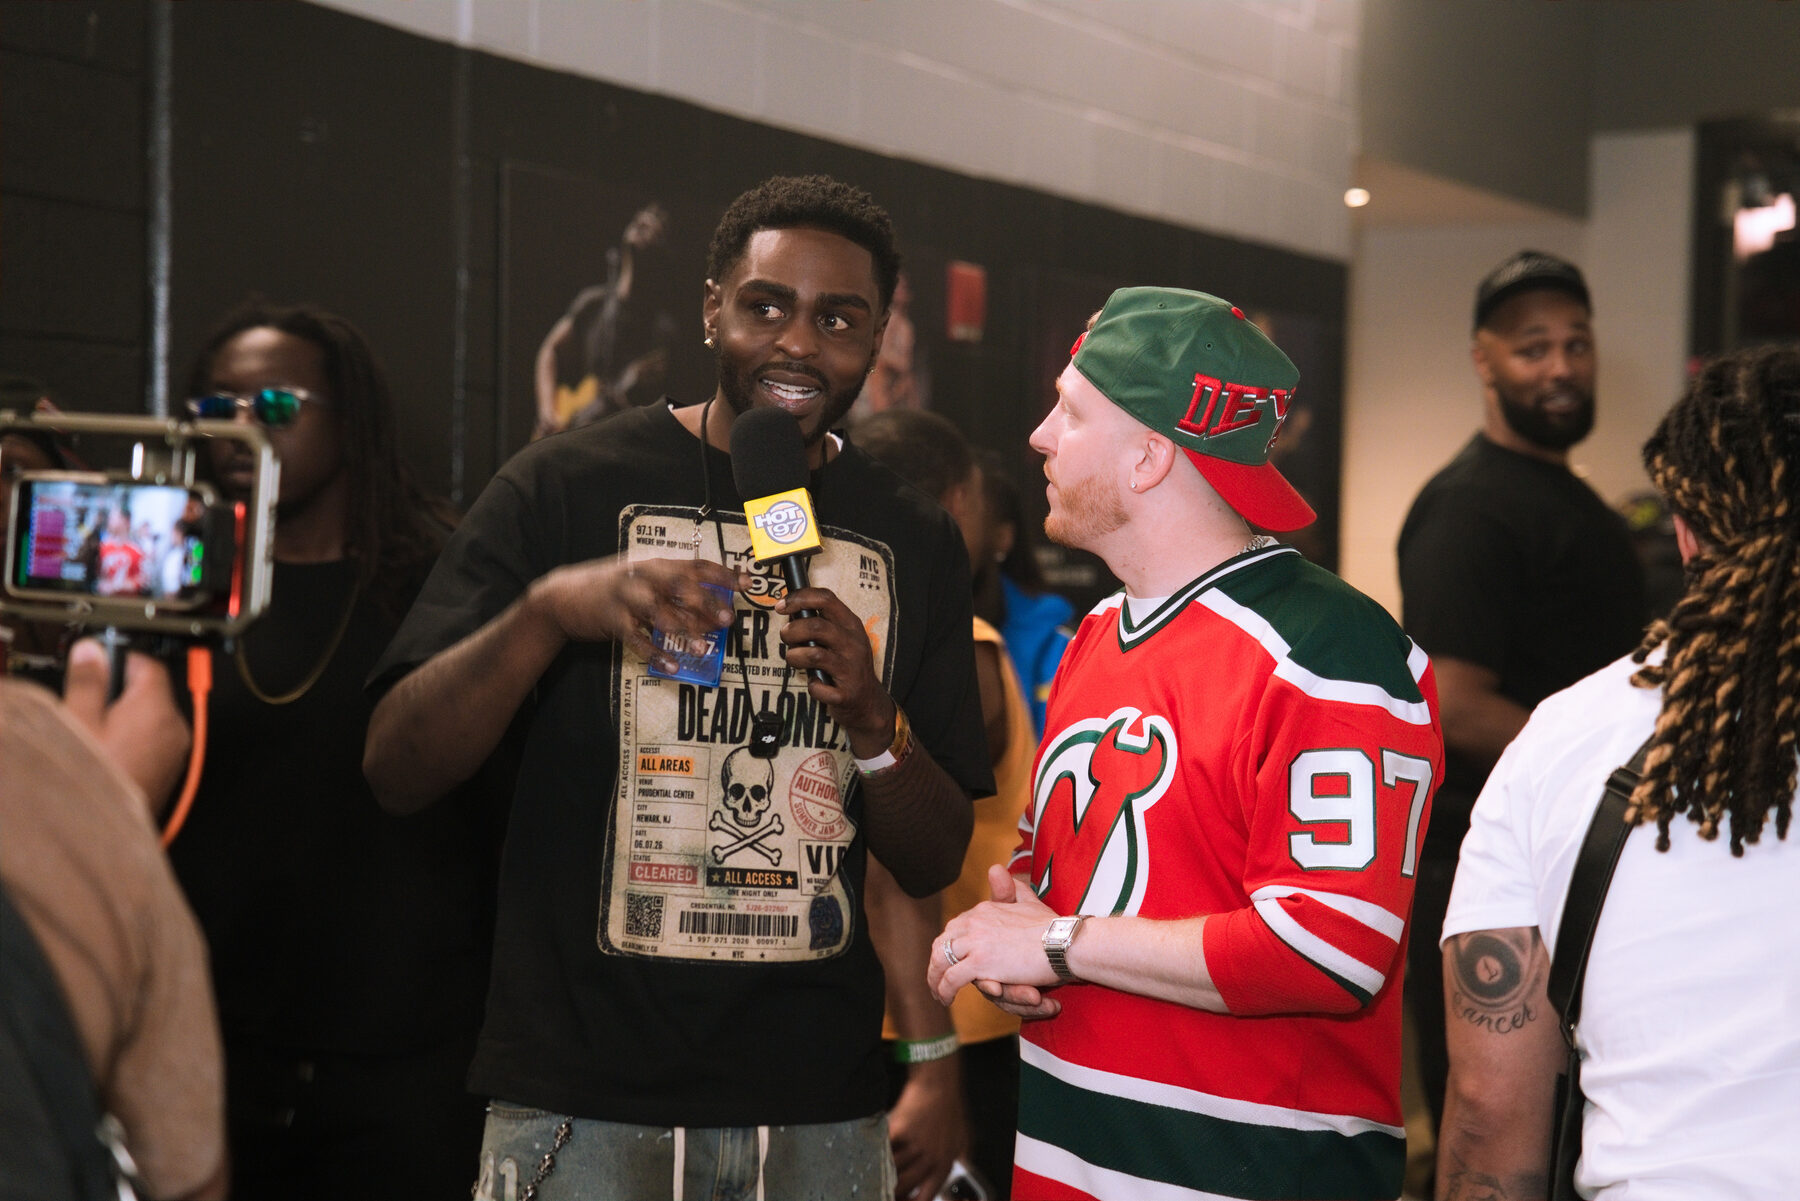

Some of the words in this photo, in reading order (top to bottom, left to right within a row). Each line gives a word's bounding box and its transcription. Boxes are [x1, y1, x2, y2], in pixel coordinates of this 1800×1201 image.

[753, 506, 800, 528] HOT
[636, 525, 652, 535] 97.1
[655, 526, 666, 537] FM
[773, 518, 804, 537] 97
[636, 538, 654, 546] WHERE
[679, 542, 693, 550] LIVES
[860, 554, 878, 574] NYC
[750, 576, 786, 596] 97
[722, 663, 760, 676] PRESETED
[762, 666, 770, 676] BY
[625, 679, 632, 690] FM
[677, 684, 748, 745] DEAD
[761, 735, 776, 744] dji
[621, 749, 630, 781] ACCESS
[641, 759, 656, 771] ALL
[659, 759, 690, 772] AREAS
[638, 788, 671, 799] PRUDENTIAL
[673, 790, 694, 799] CENTER
[636, 814, 661, 824] NEWARK,
[663, 815, 671, 823] NJ
[794, 803, 818, 833] SUMMER
[818, 825, 835, 834] JAM
[1288, 746, 1434, 880] 97
[634, 841, 662, 850] 06.07.26
[633, 854, 651, 862] STATUS
[635, 865, 693, 881] CLEARED
[724, 871, 742, 884] ALL
[745, 871, 782, 886] ACCESS
[741, 889, 760, 897] NIGHT
[763, 890, 778, 898] ONLY
[690, 902, 725, 910] CREDENTIAL
[732, 950, 744, 959] NYC
[1452, 991, 1538, 1034] Cancer
